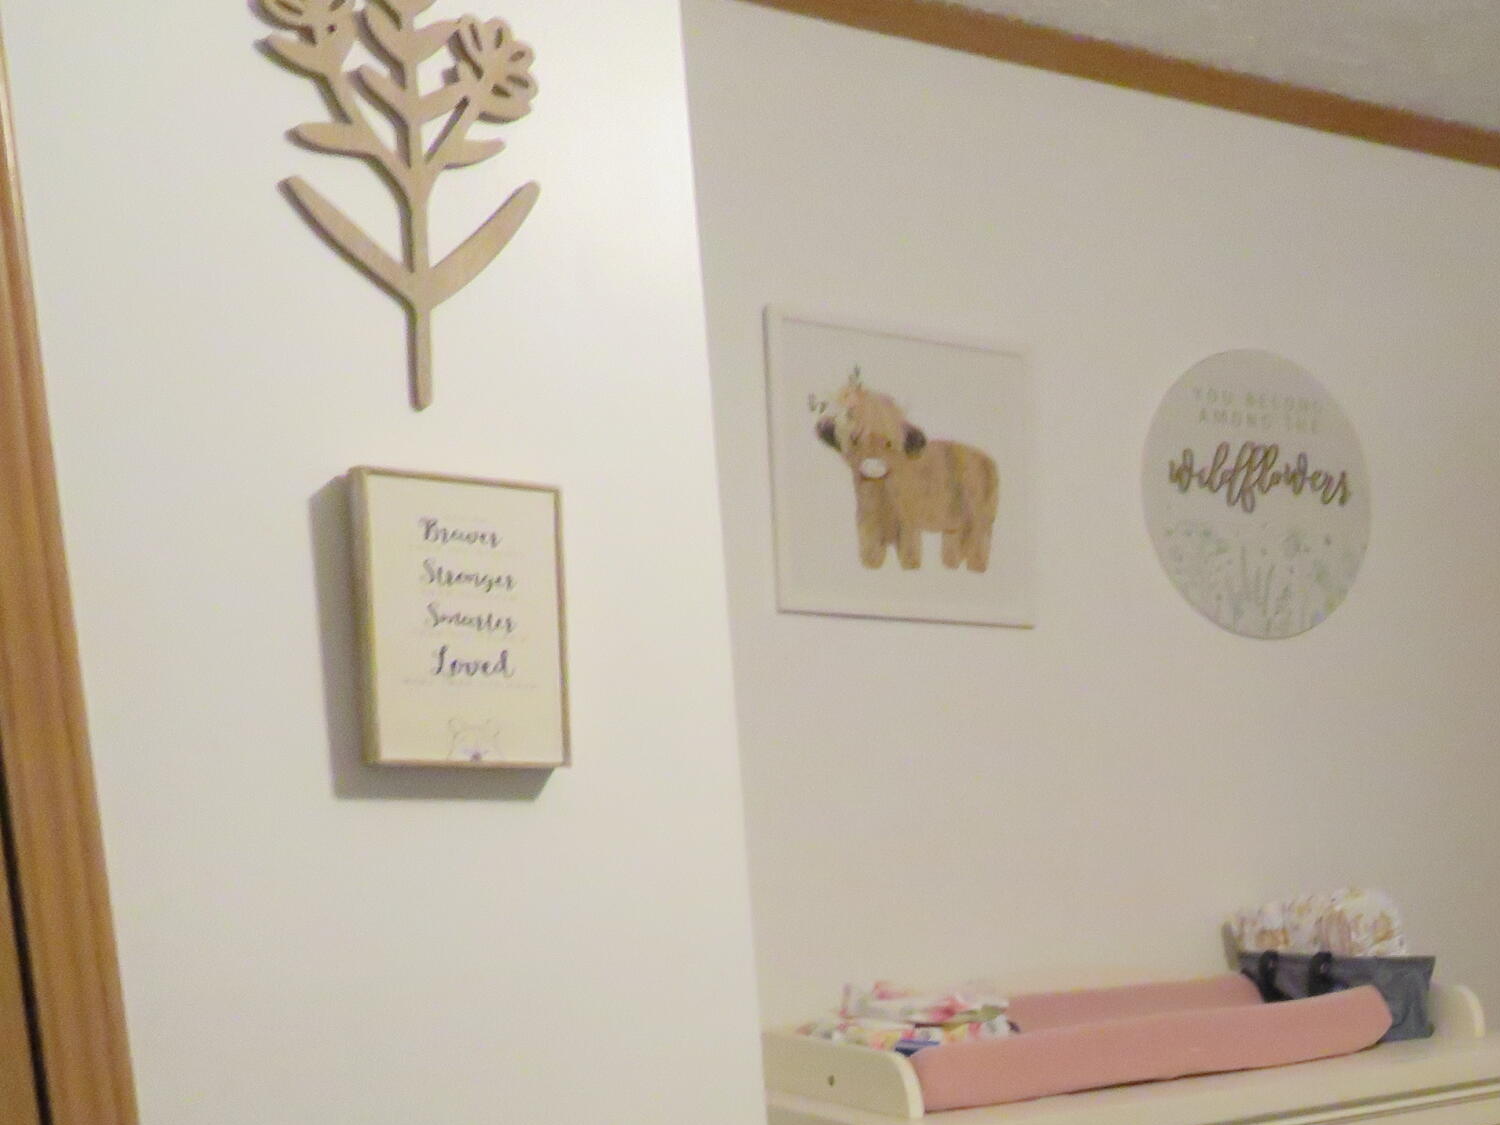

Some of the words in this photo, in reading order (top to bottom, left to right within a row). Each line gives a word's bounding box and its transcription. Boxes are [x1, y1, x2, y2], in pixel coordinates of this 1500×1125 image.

[1168, 441, 1352, 513] wildflowers
[419, 516, 502, 547] Braver
[421, 559, 516, 593] Stronger
[426, 602, 517, 635] Smarter
[433, 646, 514, 677] Loved
